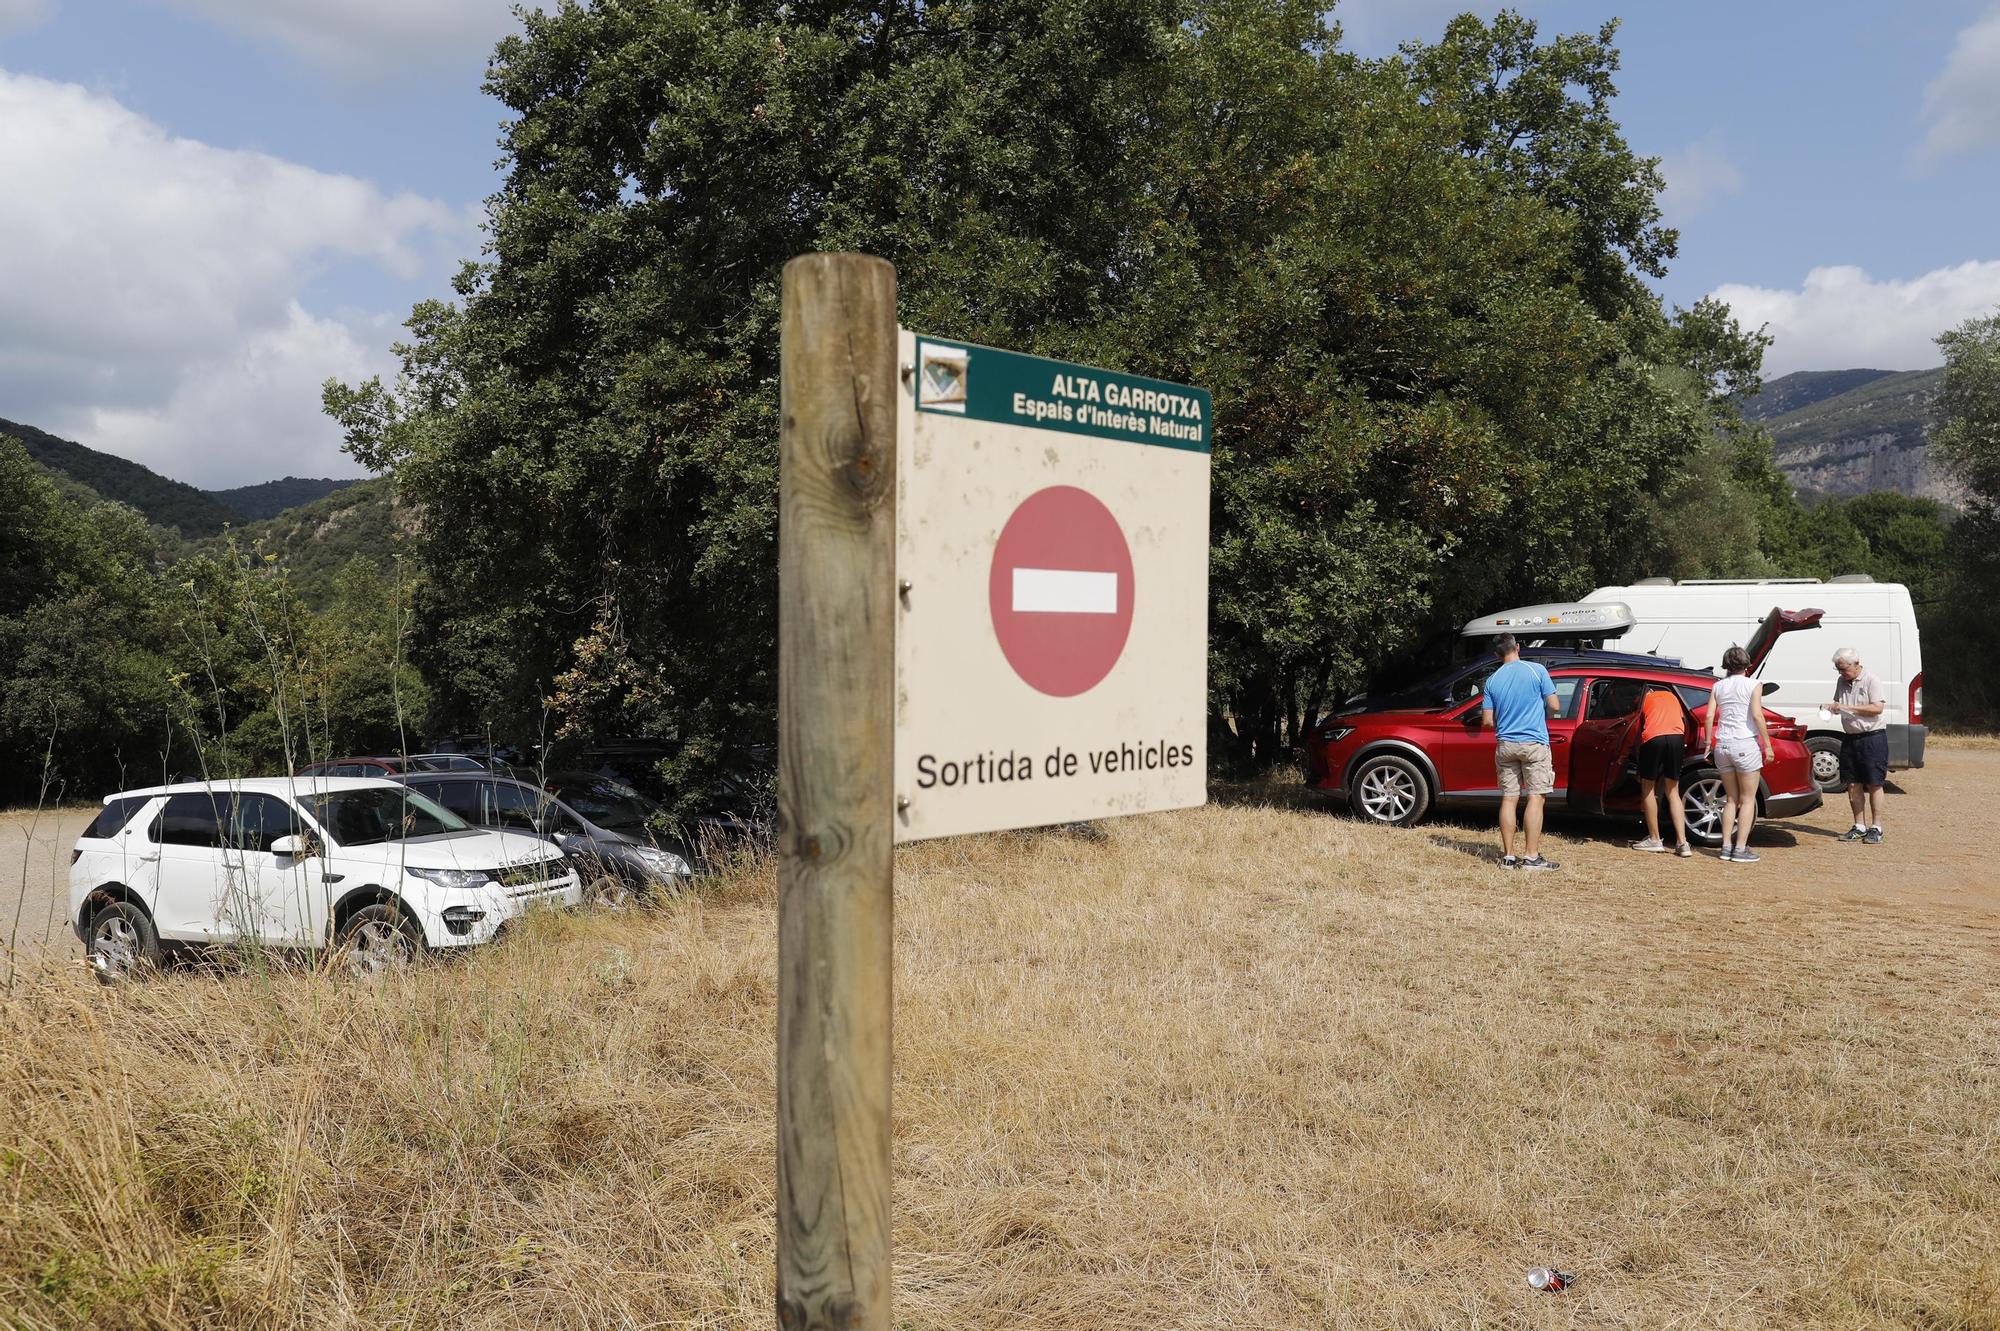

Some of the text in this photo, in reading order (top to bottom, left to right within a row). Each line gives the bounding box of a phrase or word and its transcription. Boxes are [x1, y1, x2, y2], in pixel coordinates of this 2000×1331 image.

[1013, 393, 1202, 441] Espais d'Interès Natural
[1052, 374, 1201, 419] ALTA GARROTXA
[916, 740, 1193, 789] Sortida de vehicles
